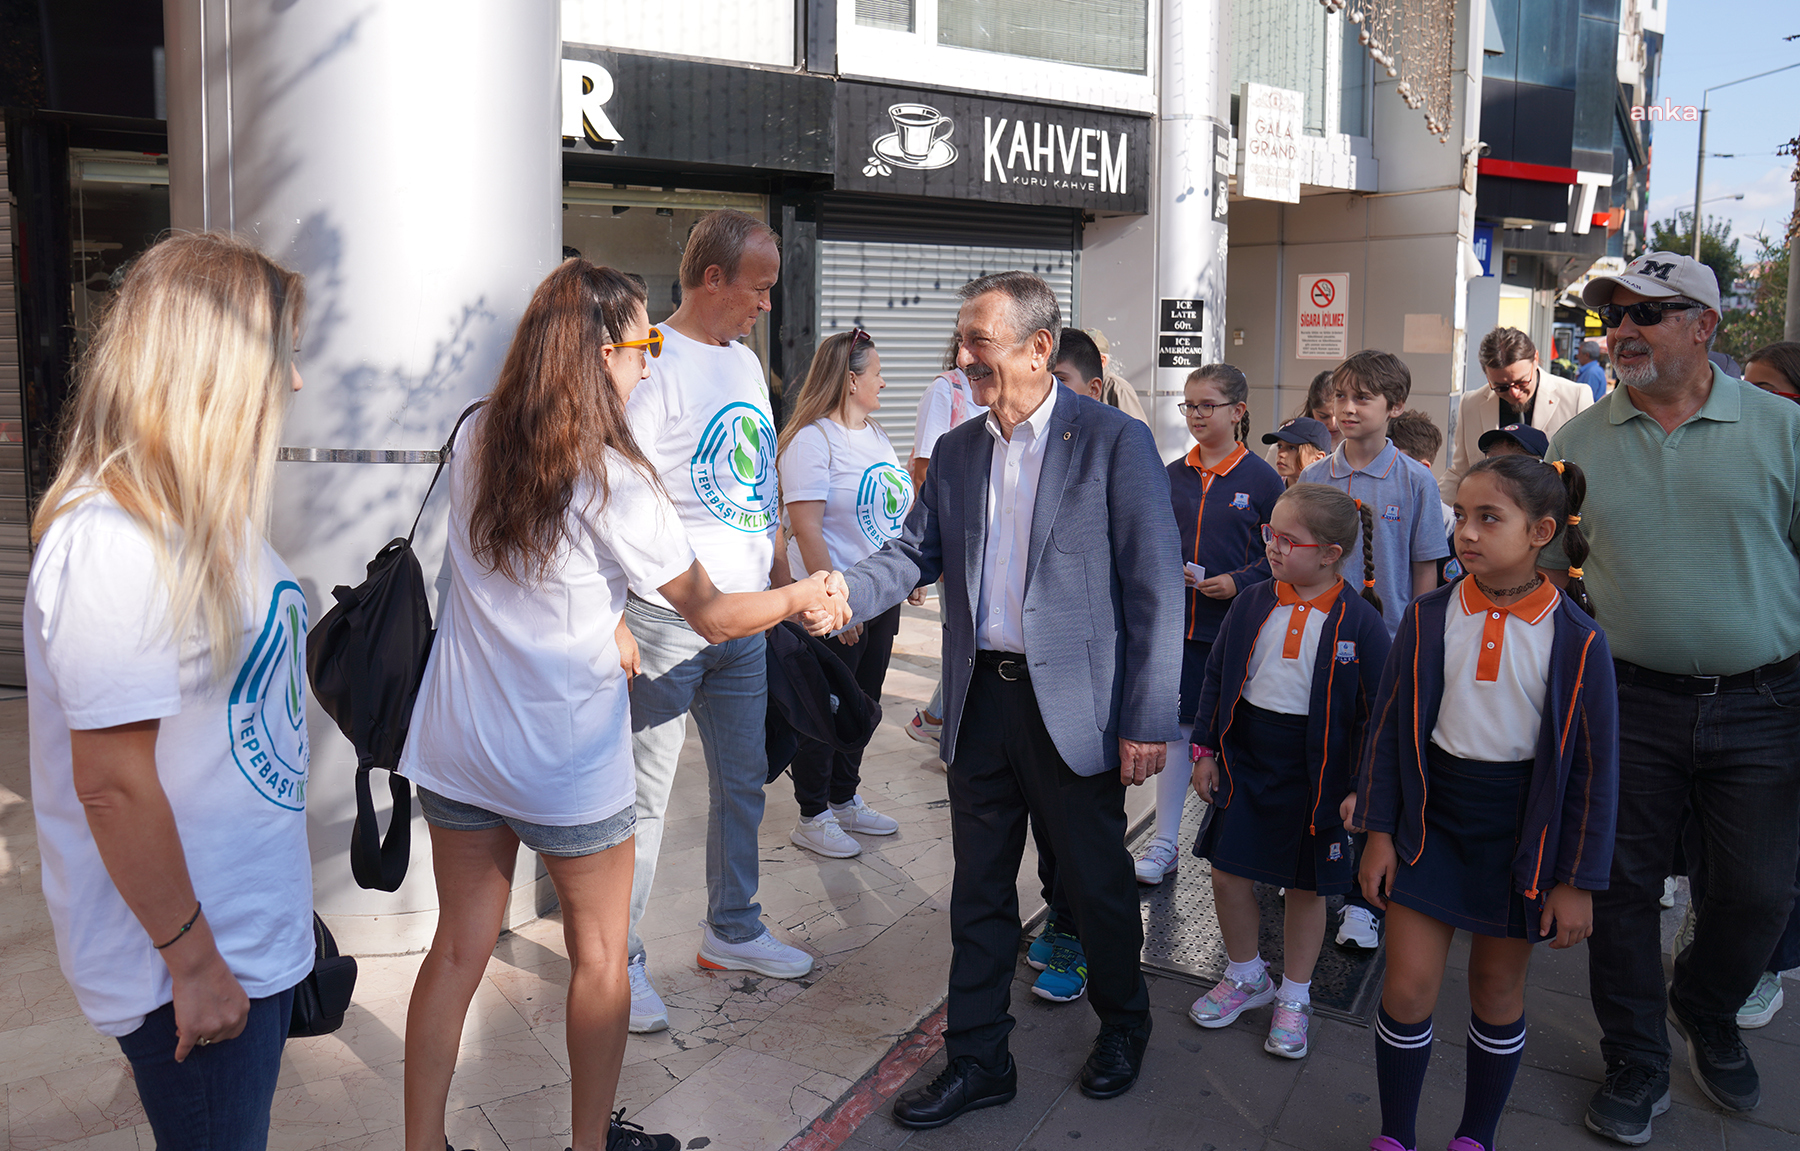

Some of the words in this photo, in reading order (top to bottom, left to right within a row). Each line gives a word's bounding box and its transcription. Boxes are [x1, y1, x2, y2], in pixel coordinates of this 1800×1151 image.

[1255, 119, 1294, 141] GALA
[984, 116, 1128, 195] KAHVE'M
[1249, 140, 1297, 160] GRAND
[1012, 176, 1048, 187] KURU
[1053, 181, 1096, 192] KAHVE
[1637, 260, 1678, 282] M
[1176, 300, 1193, 309] ICE
[1171, 310, 1197, 319] LATTE
[1300, 311, 1321, 328] SİGARA
[1174, 320, 1193, 330] 60TL
[1175, 337, 1191, 346] ICE
[1172, 355, 1192, 366] 50TL
[697, 468, 737, 521] TEPEBAŞI
[240, 711, 295, 799] TEPEBAŞI
